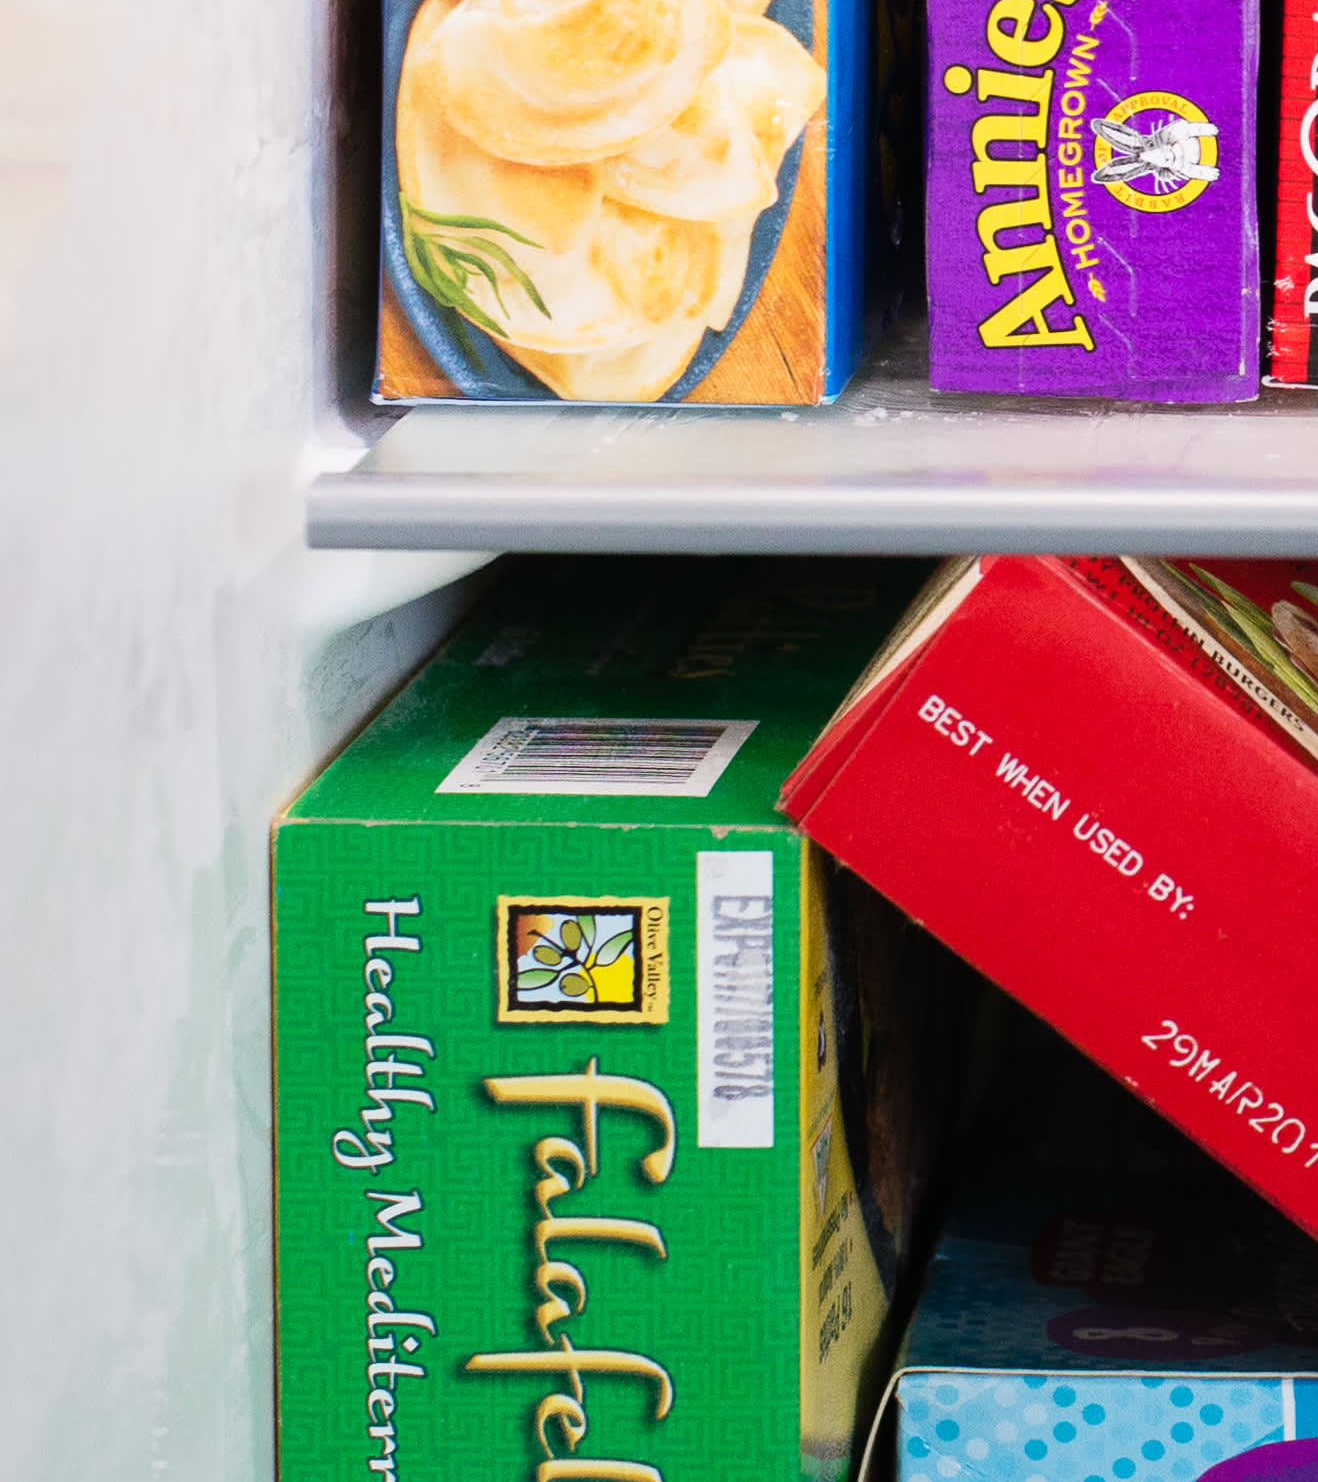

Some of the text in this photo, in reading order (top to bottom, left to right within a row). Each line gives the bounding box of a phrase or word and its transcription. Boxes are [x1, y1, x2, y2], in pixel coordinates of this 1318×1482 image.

[1058, 34, 1101, 271] HOMEGROWN
[917, 694, 1196, 921] BEST WHEN USED BY:
[331, 893, 436, 1175] Healthy
[646, 905, 664, 1002] Olive Valley
